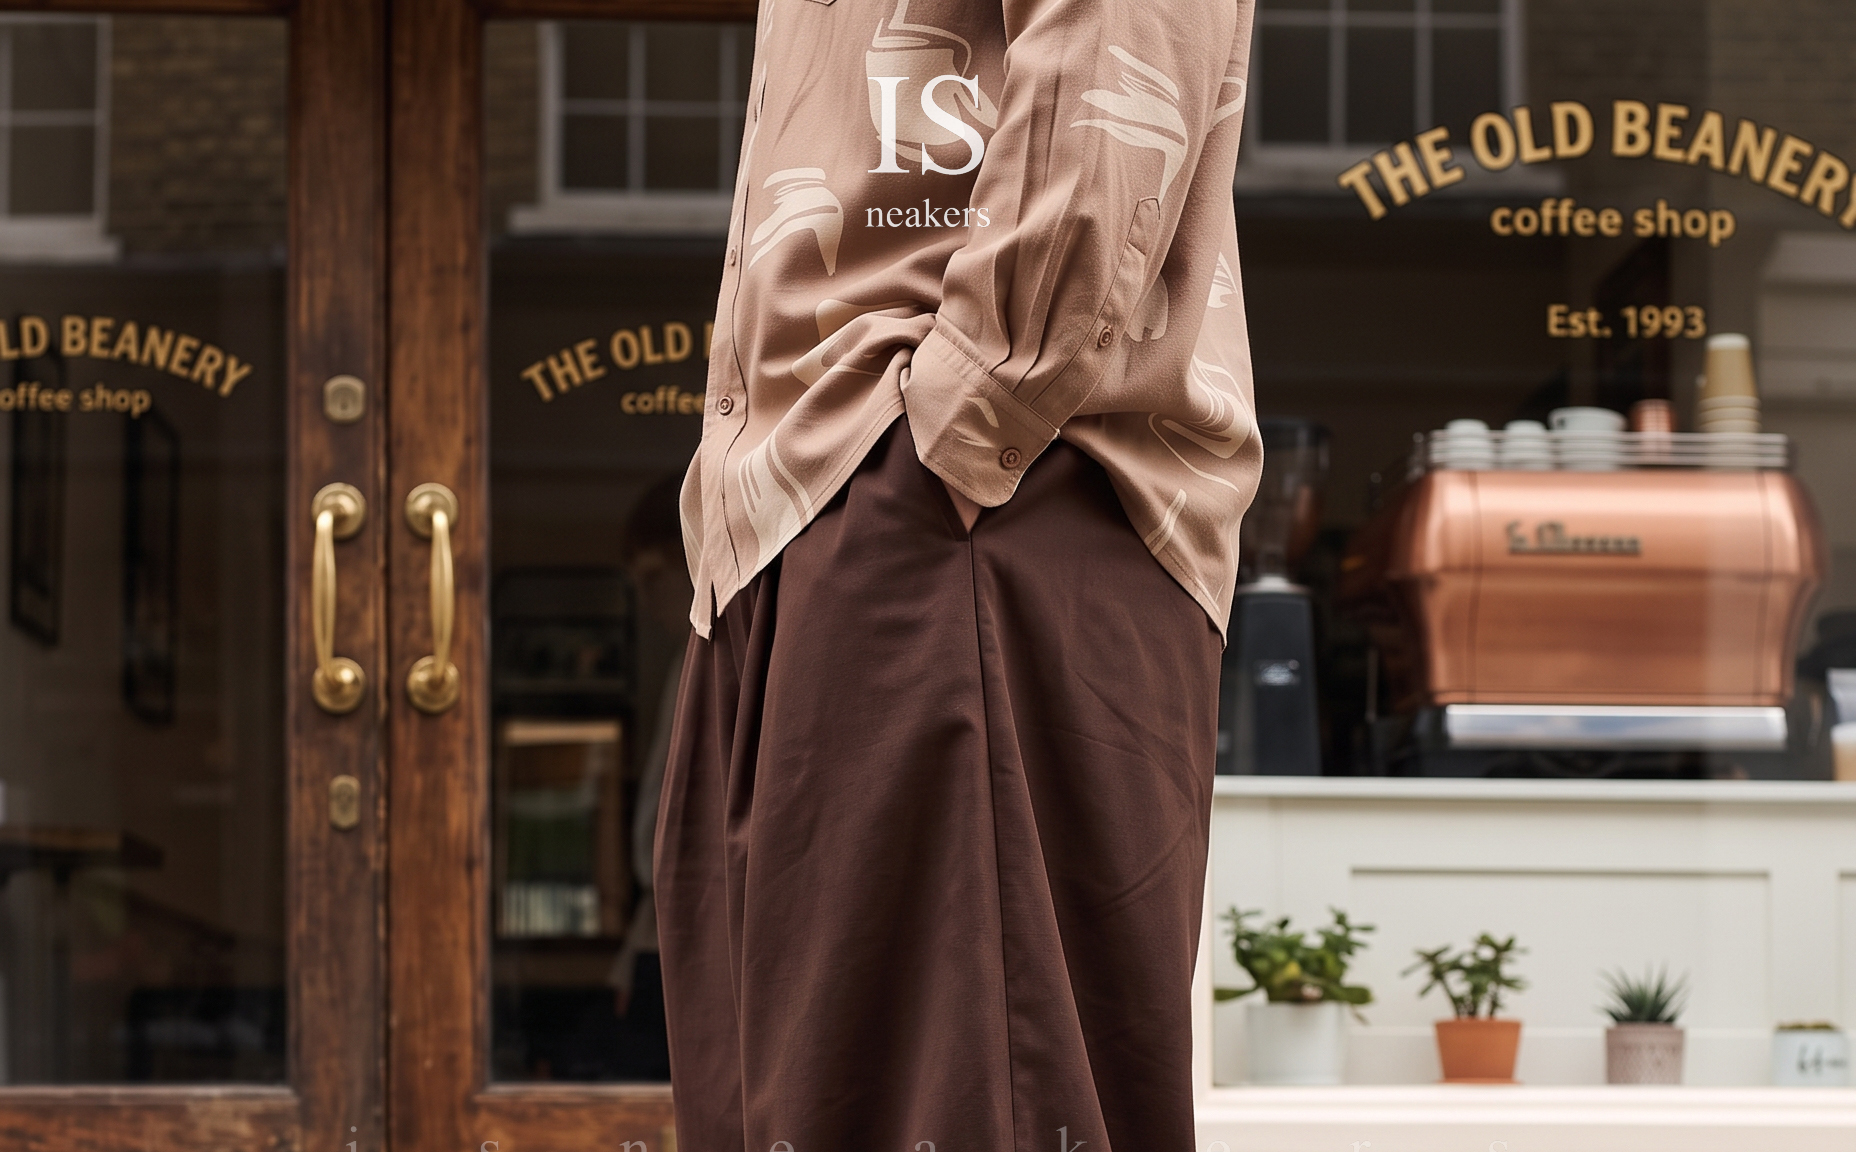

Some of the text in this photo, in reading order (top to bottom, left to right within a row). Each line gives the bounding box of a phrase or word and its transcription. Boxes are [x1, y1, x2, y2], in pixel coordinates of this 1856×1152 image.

[1338, 126, 1465, 220] THE
[1470, 101, 1595, 170] OLD
[1490, 199, 1736, 247] coffee shop
[1547, 304, 1706, 338] Est. 1993
[60, 314, 253, 397] BEANERY
[520, 338, 607, 402] THE
[609, 321, 693, 370] OLD
[79, 382, 152, 419] shop
[621, 384, 705, 415] coffee
